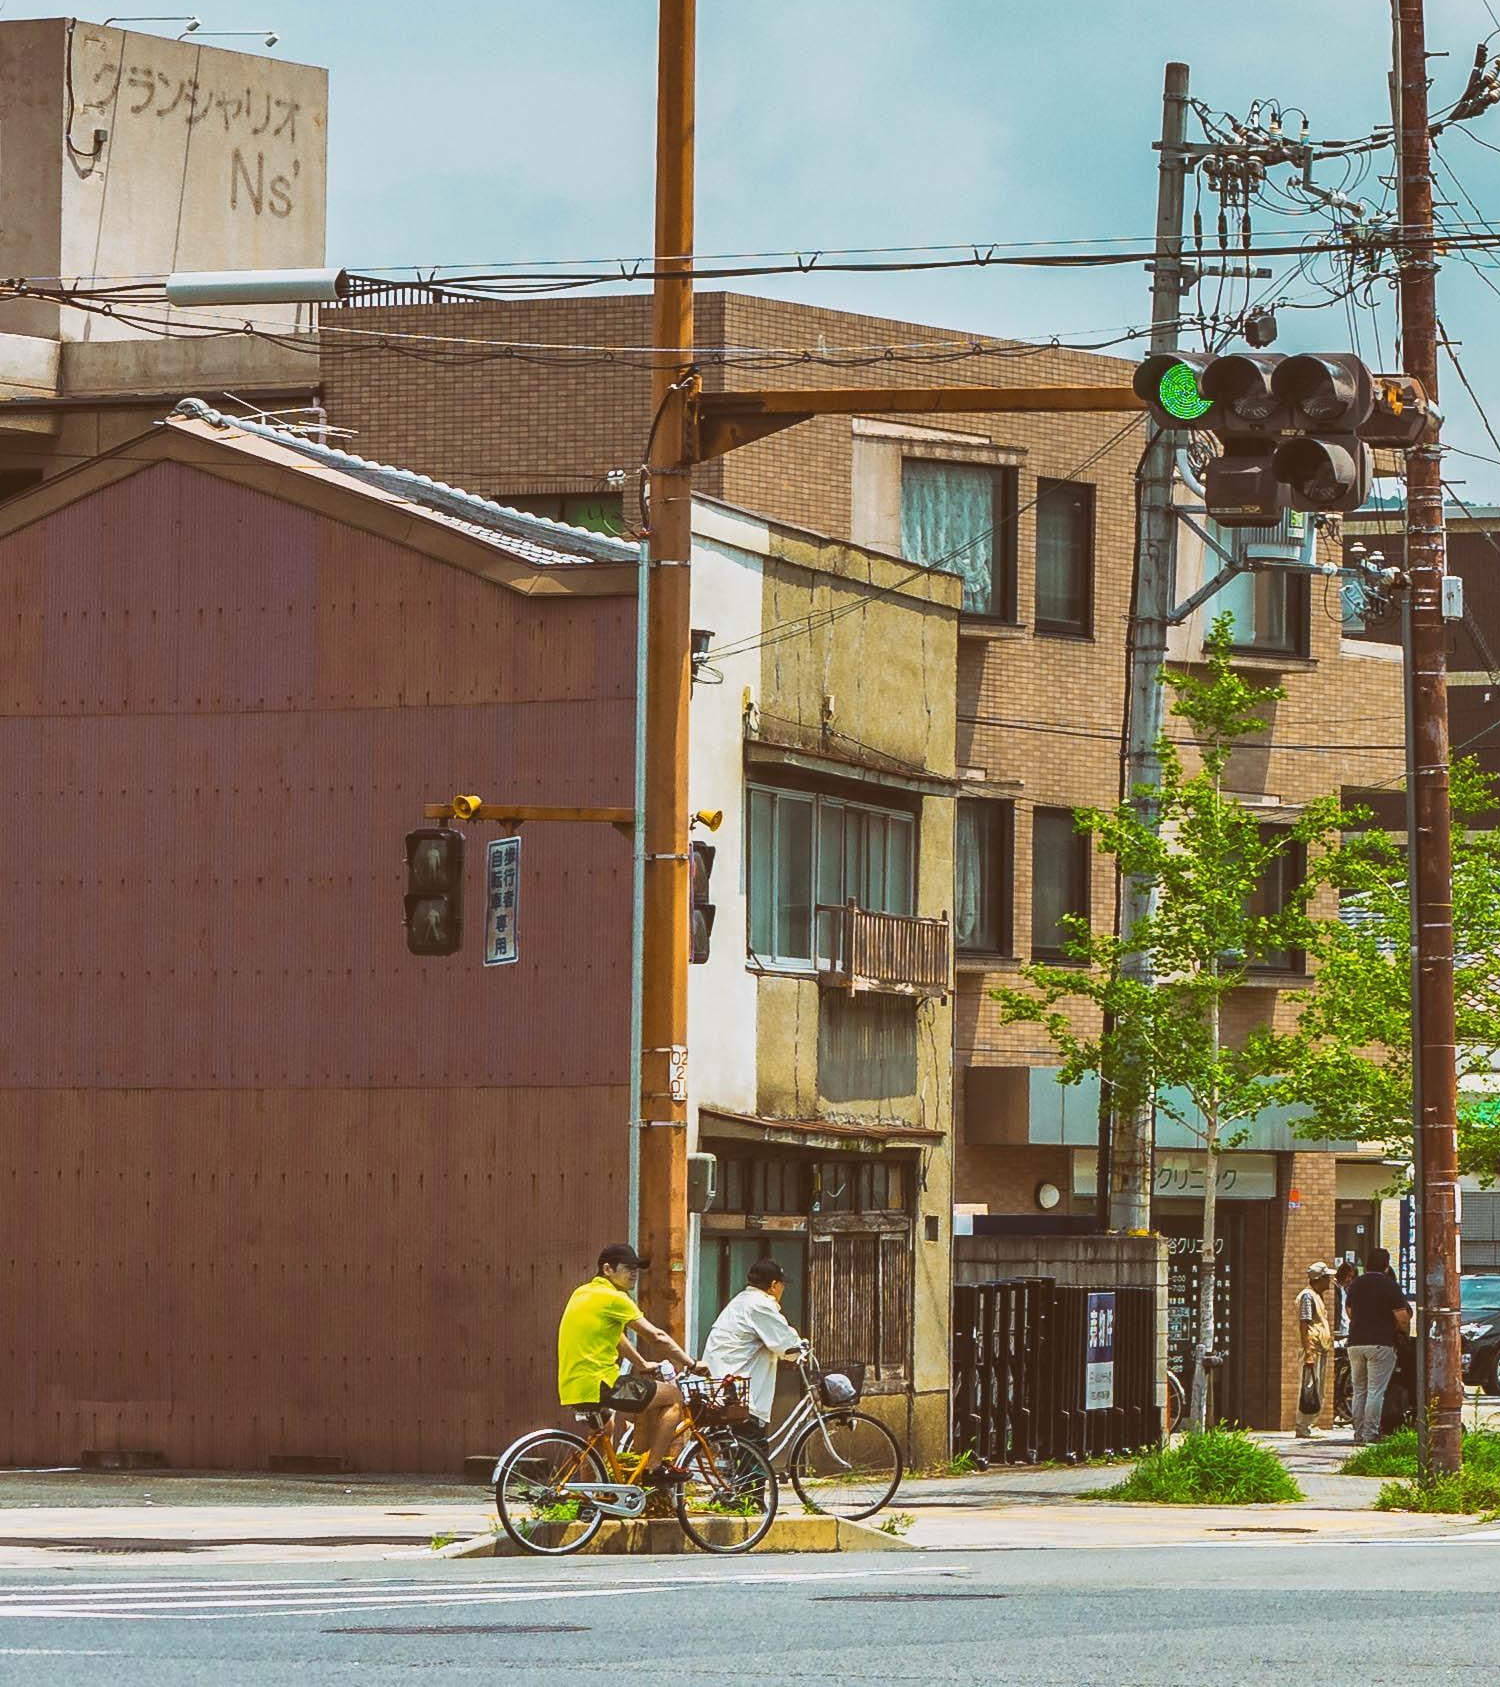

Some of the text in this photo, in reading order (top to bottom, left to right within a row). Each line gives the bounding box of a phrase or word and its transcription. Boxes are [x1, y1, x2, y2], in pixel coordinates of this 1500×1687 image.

[495, 914, 507, 955] 専用
[1157, 1167, 1238, 1191] クリニク
[1168, 1237, 1224, 1255] 谷クリニク
